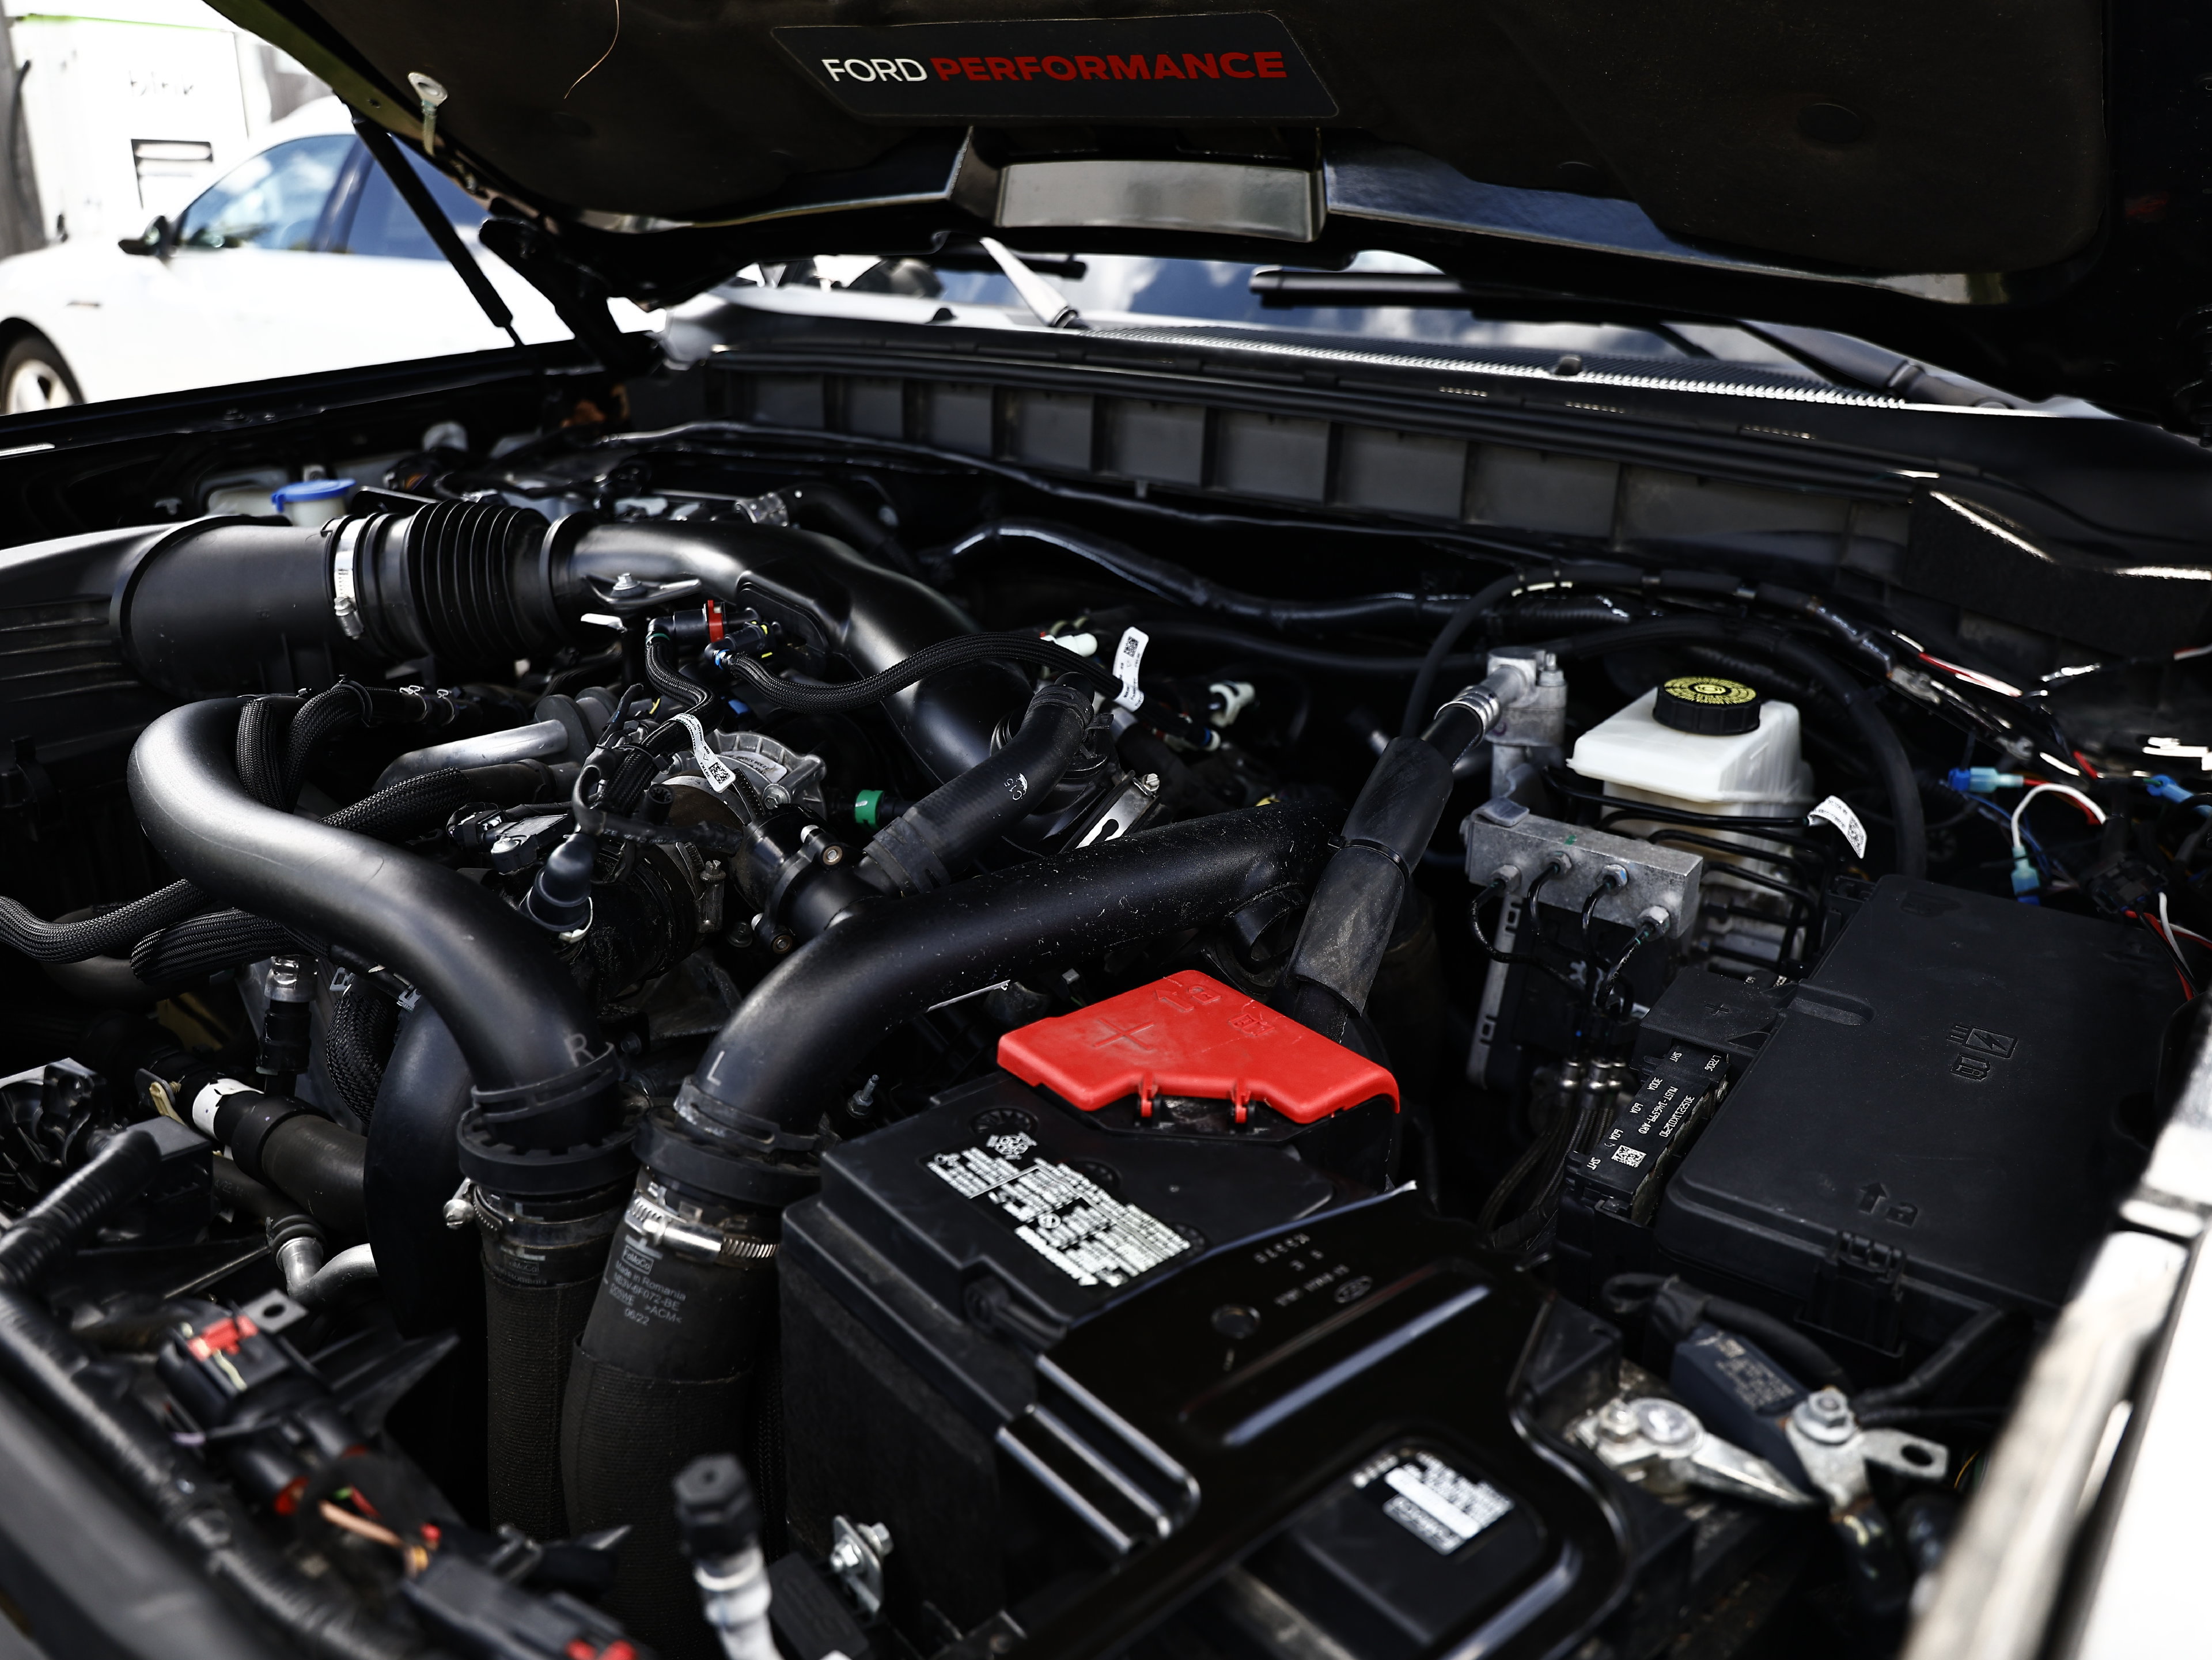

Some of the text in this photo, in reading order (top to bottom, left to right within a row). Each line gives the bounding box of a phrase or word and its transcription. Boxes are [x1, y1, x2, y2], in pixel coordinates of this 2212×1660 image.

[820, 51, 1288, 83] FORD PERFORMANCE
[564, 1033, 596, 1067] R
[1669, 1051, 1682, 1063] SHT
[706, 1050, 726, 1086] L
[1647, 1077, 1663, 1091] 300A
[1629, 1102, 1644, 1114] 60A
[1609, 1128, 1624, 1141] 60A
[1587, 1157, 1601, 1170] SHT
[615, 1260, 632, 1278] Made
[633, 1274, 641, 1283] in
[642, 1277, 686, 1301] Romania
